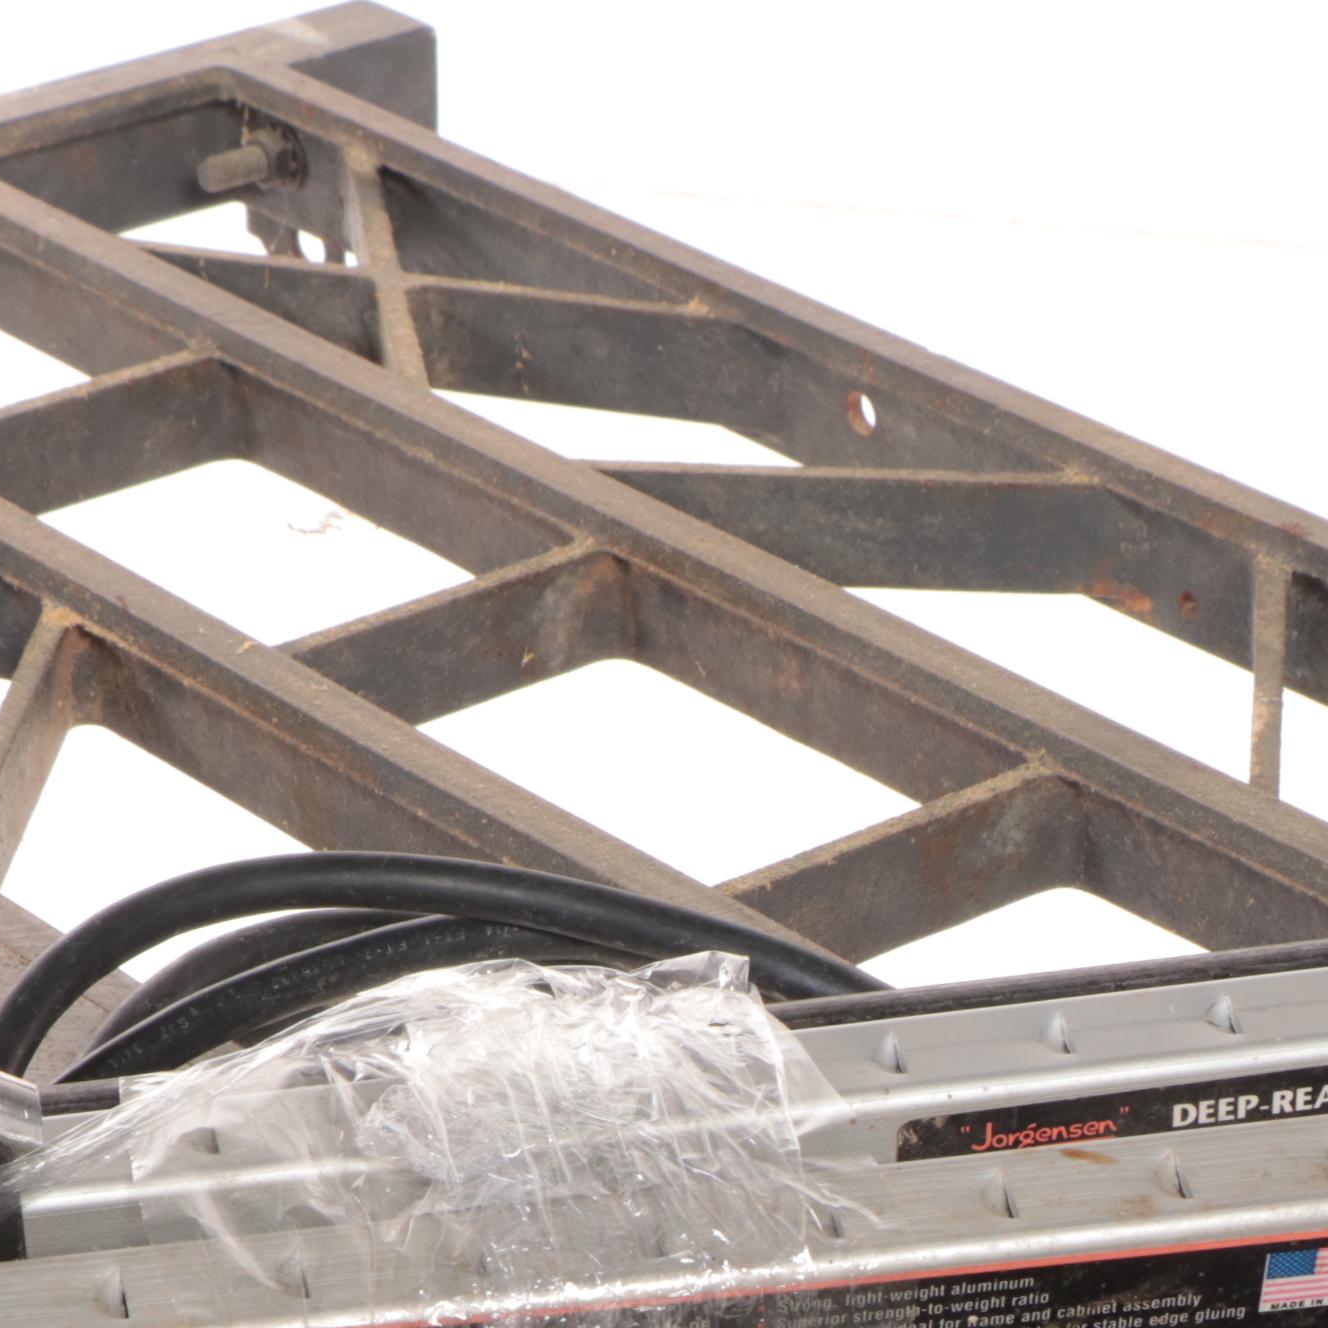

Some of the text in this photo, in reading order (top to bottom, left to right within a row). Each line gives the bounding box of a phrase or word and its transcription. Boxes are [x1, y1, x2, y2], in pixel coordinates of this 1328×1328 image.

[845, 1284, 947, 1308] light-weight
[950, 1276, 1035, 1296] aluminum
[1020, 1307, 1052, 1323] and
[1056, 1299, 1118, 1319] cabinet
[1122, 1292, 1202, 1313] assembly
[1270, 1300, 1306, 1311] MADE
[1310, 1298, 1323, 1307] IN
[852, 1294, 1006, 1324] strength-to-weight
[1011, 1292, 1050, 1306] ratio
[1149, 1309, 1189, 1327] edge
[1194, 1304, 1246, 1324] gluing
